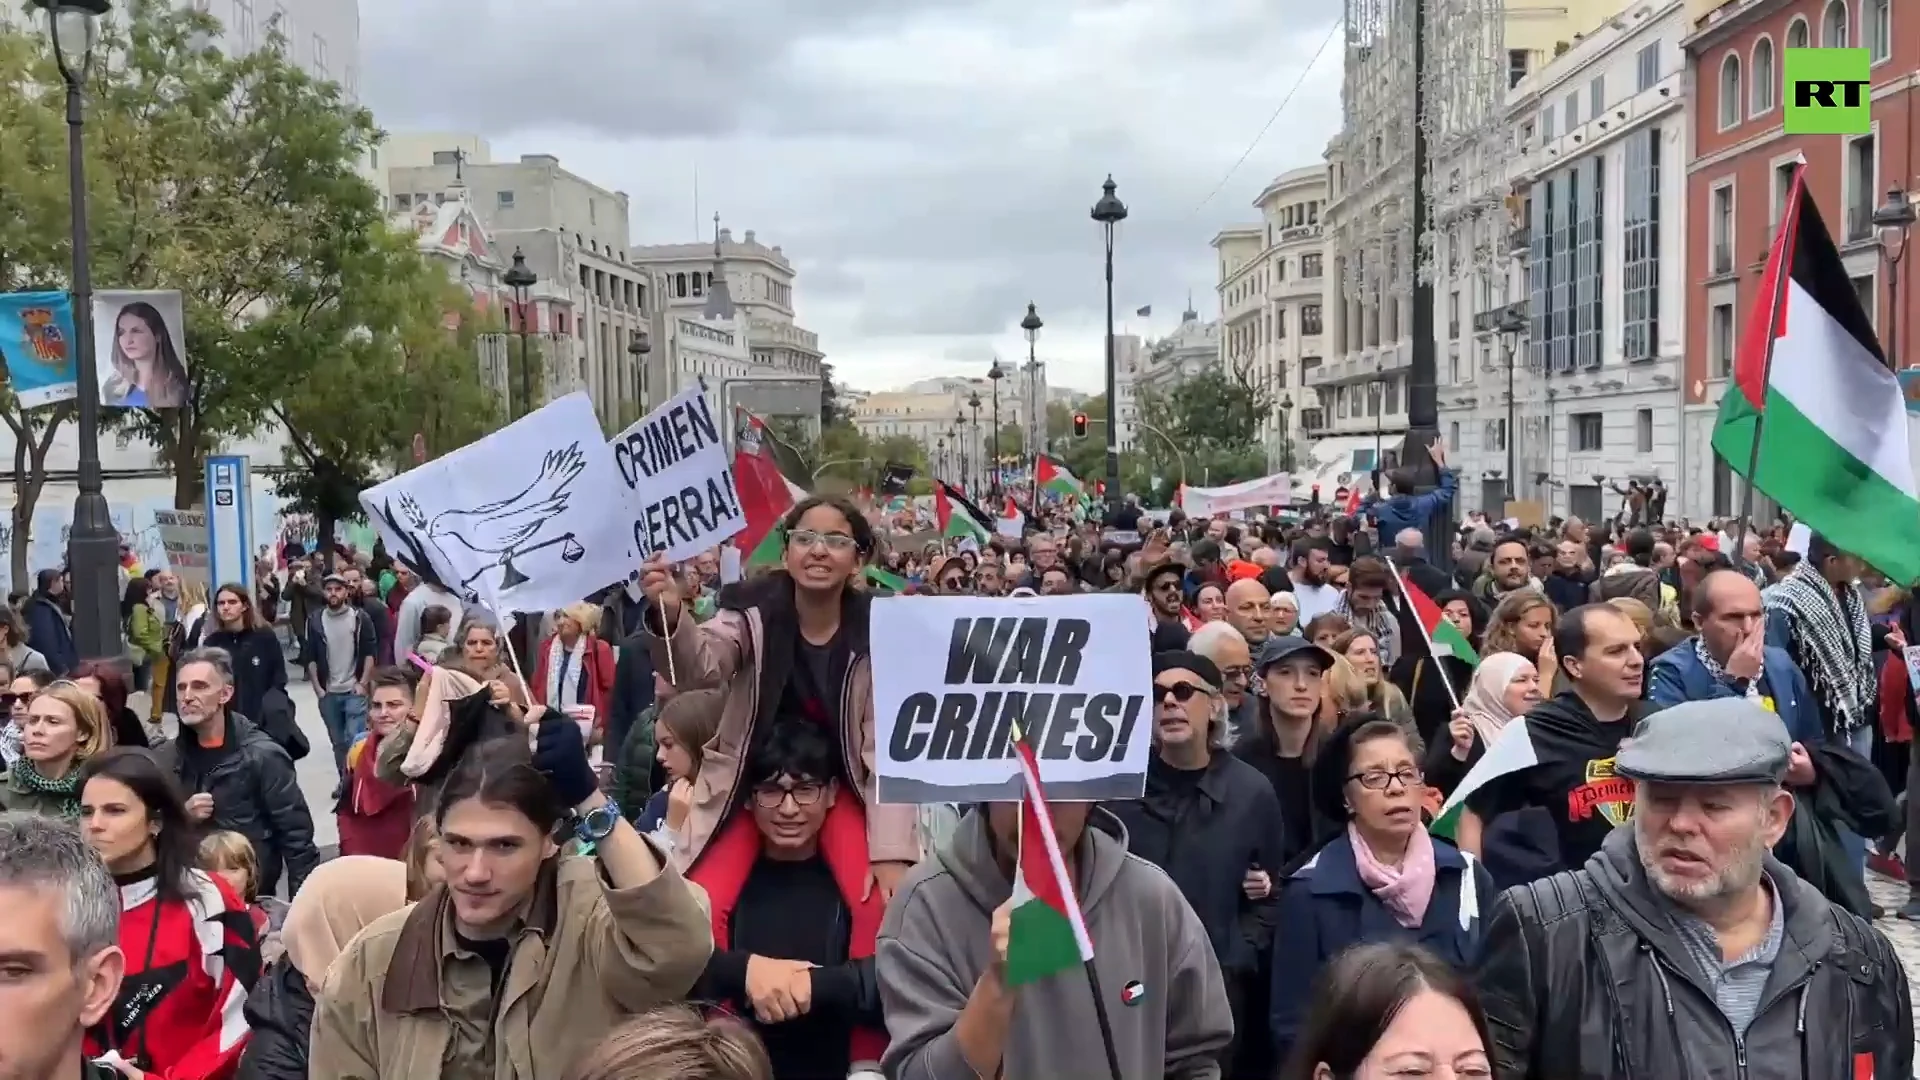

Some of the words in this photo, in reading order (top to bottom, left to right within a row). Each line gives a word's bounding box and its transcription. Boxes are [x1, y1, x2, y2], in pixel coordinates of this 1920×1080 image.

[614, 395, 720, 490] CRIMEN
[944, 616, 1091, 686] WAR
[888, 691, 1145, 763] CRIMES!
